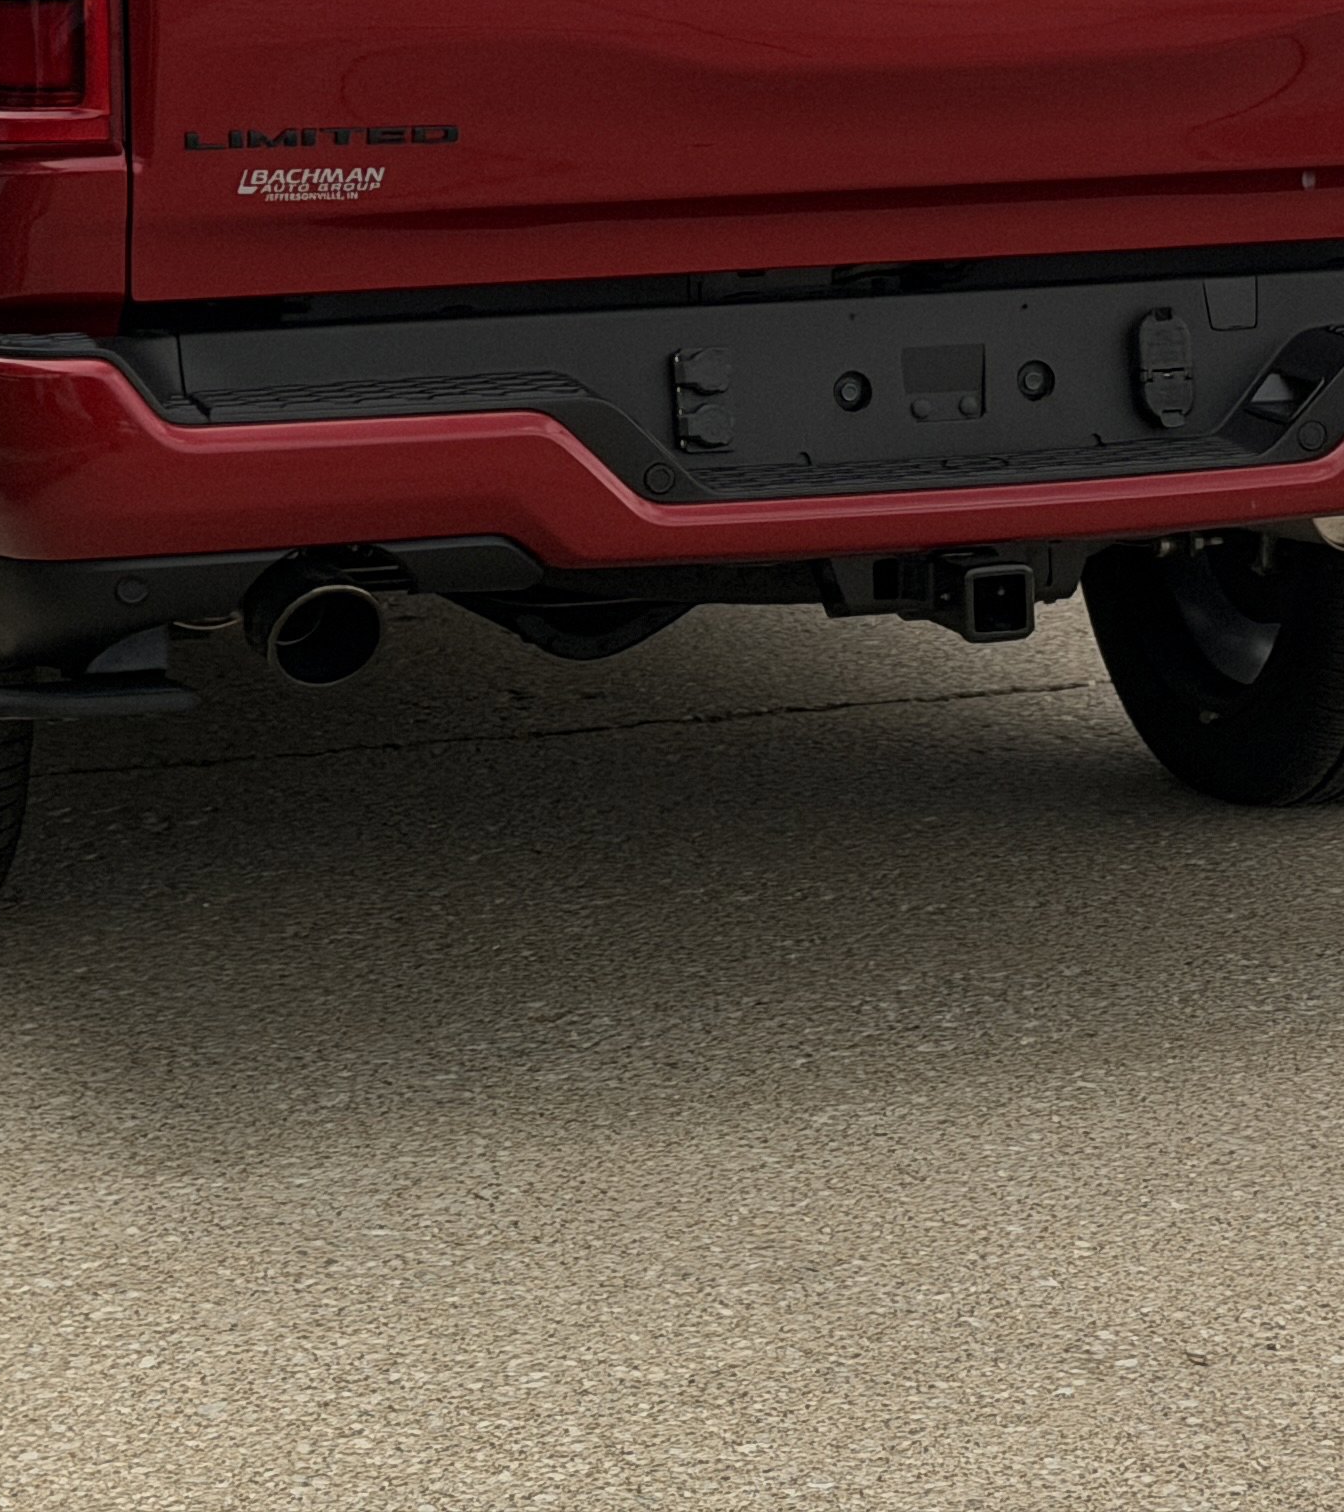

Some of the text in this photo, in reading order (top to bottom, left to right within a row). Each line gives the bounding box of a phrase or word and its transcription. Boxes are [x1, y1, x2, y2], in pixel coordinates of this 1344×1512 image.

[184, 125, 460, 150] LIMITED
[250, 167, 385, 185] BACHMAN
[260, 182, 381, 194] AUTO GROUP
[265, 191, 359, 202] JEFFERSONVILLE, IN
